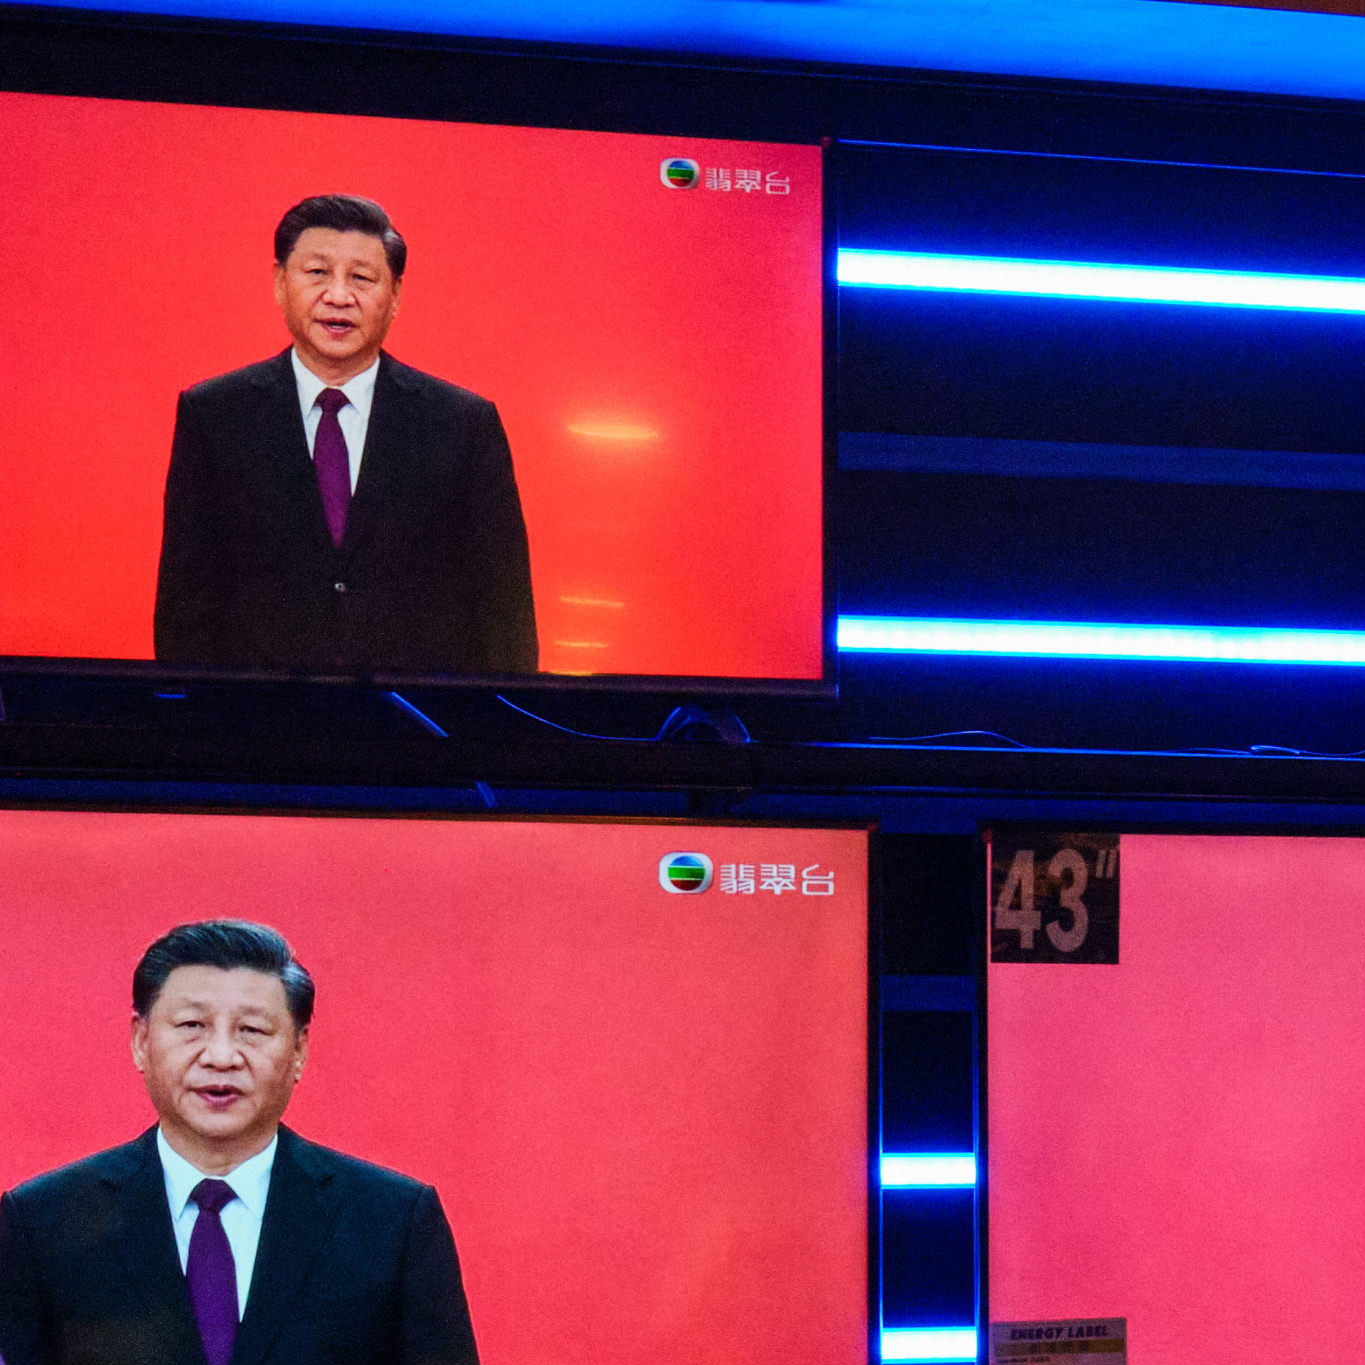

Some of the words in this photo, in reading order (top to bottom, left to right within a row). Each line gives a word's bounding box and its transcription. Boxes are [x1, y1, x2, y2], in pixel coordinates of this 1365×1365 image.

[706, 168, 790, 195] 翡翠台
[720, 864, 834, 896] 翡翠台
[993, 849, 1118, 953] 43"
[1010, 1327, 1064, 1340] ENERGY
[1068, 1325, 1108, 1338] LABEL
